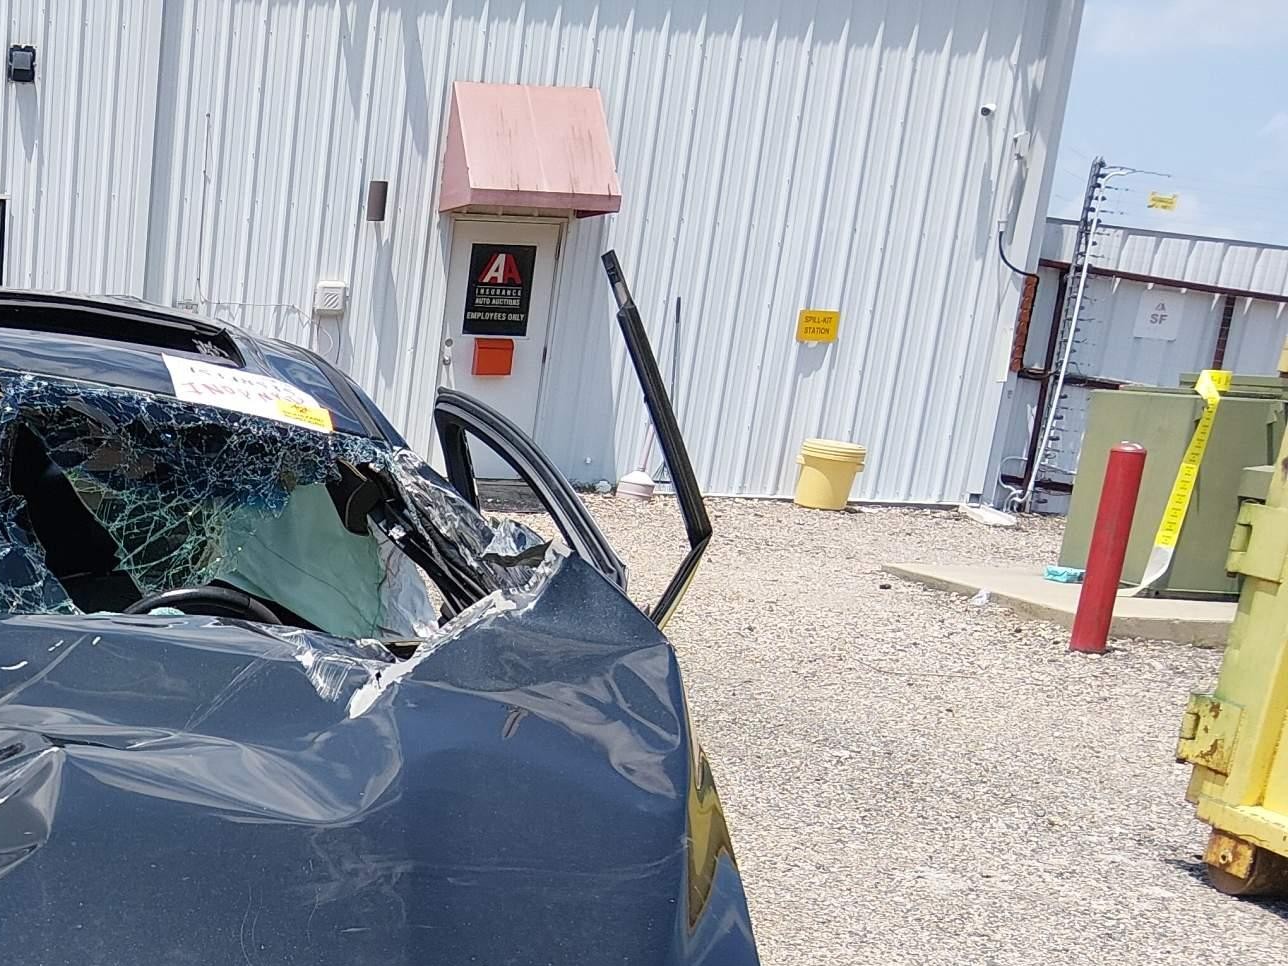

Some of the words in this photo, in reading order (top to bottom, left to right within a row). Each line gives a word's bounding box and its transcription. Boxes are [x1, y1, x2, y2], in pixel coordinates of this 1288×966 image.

[475, 287, 521, 297] INSURANCE
[475, 297, 491, 305] AUTO
[491, 298, 520, 306] AUCTIONS
[466, 311, 508, 321] EMPLOYEES
[508, 313, 525, 321] ONLY
[1150, 313, 1169, 325] SF
[803, 326, 830, 335] STATION
